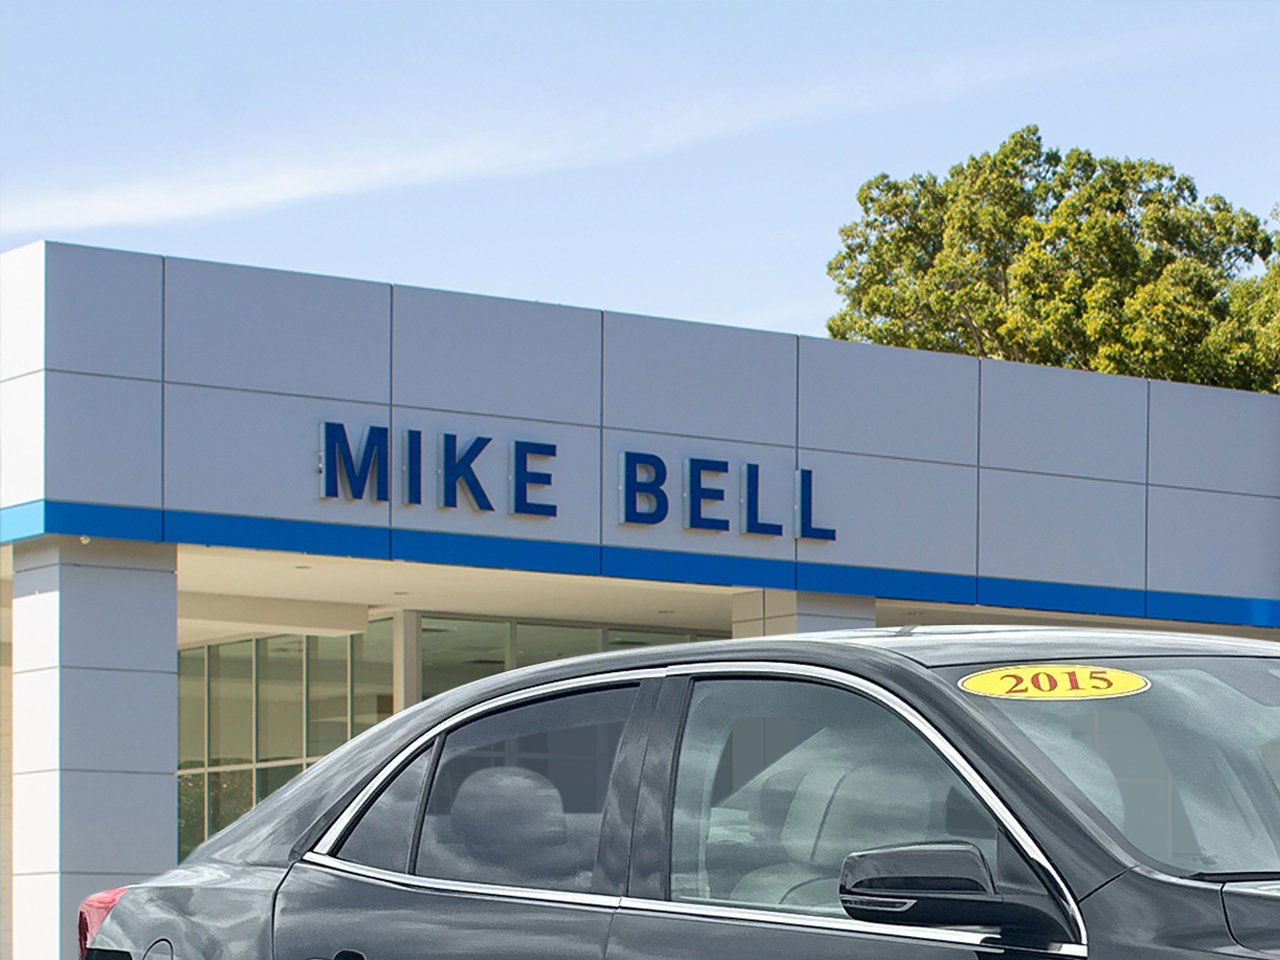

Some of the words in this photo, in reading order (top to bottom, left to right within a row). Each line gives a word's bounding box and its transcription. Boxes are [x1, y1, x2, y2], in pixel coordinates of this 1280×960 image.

[319, 421, 558, 518] MIKE
[618, 450, 838, 542] BELL
[999, 670, 1114, 694] 2015
